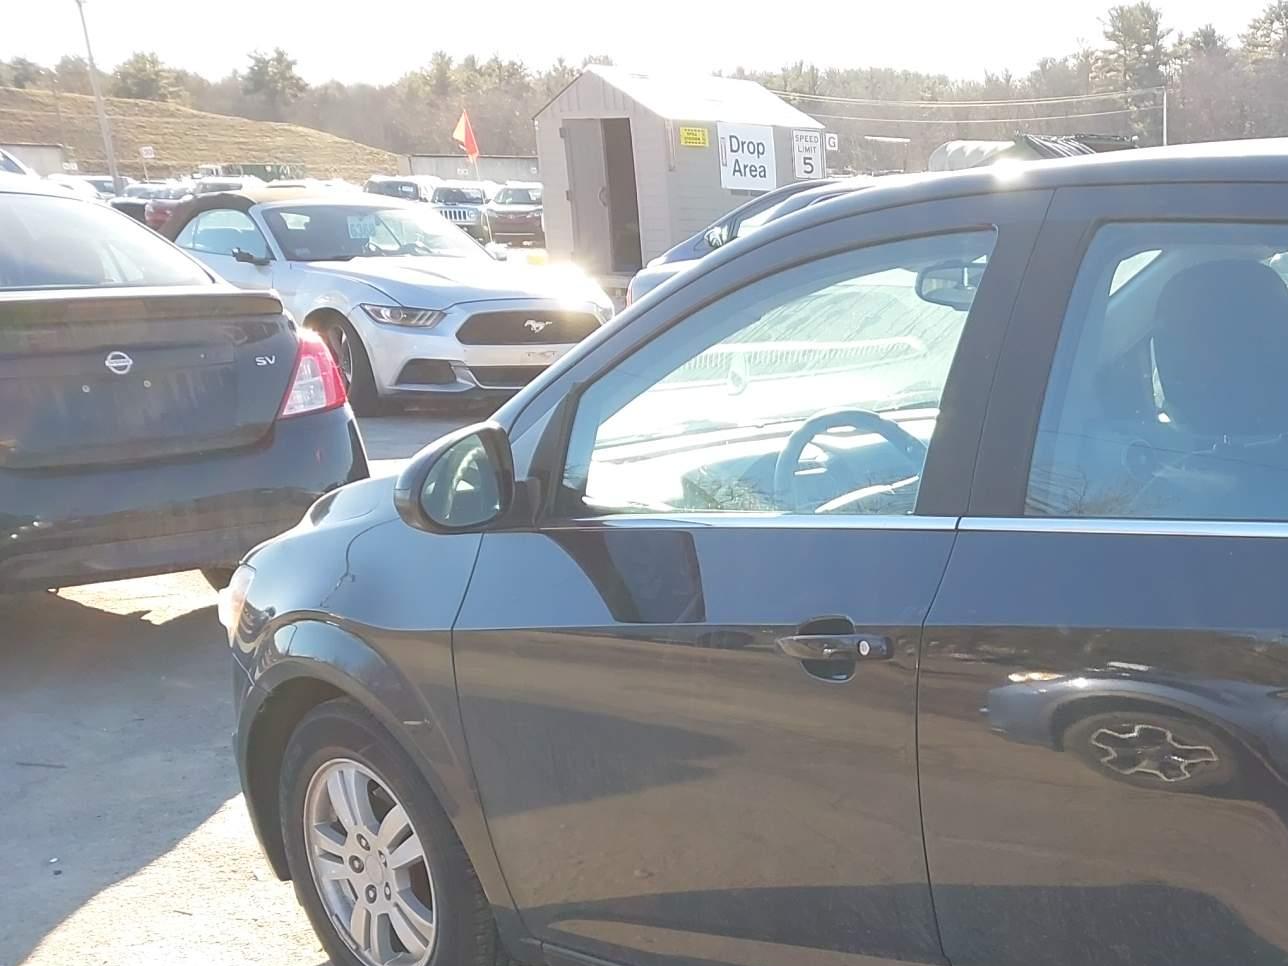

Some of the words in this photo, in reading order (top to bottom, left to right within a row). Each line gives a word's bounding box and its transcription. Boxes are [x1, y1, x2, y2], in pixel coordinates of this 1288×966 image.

[795, 134, 819, 144] SPEED
[828, 136, 837, 148] G
[729, 135, 765, 158] Drop
[798, 145, 817, 154] LIMIT
[733, 158, 767, 178] Area
[803, 156, 815, 175] 5
[256, 355, 275, 365] SV
